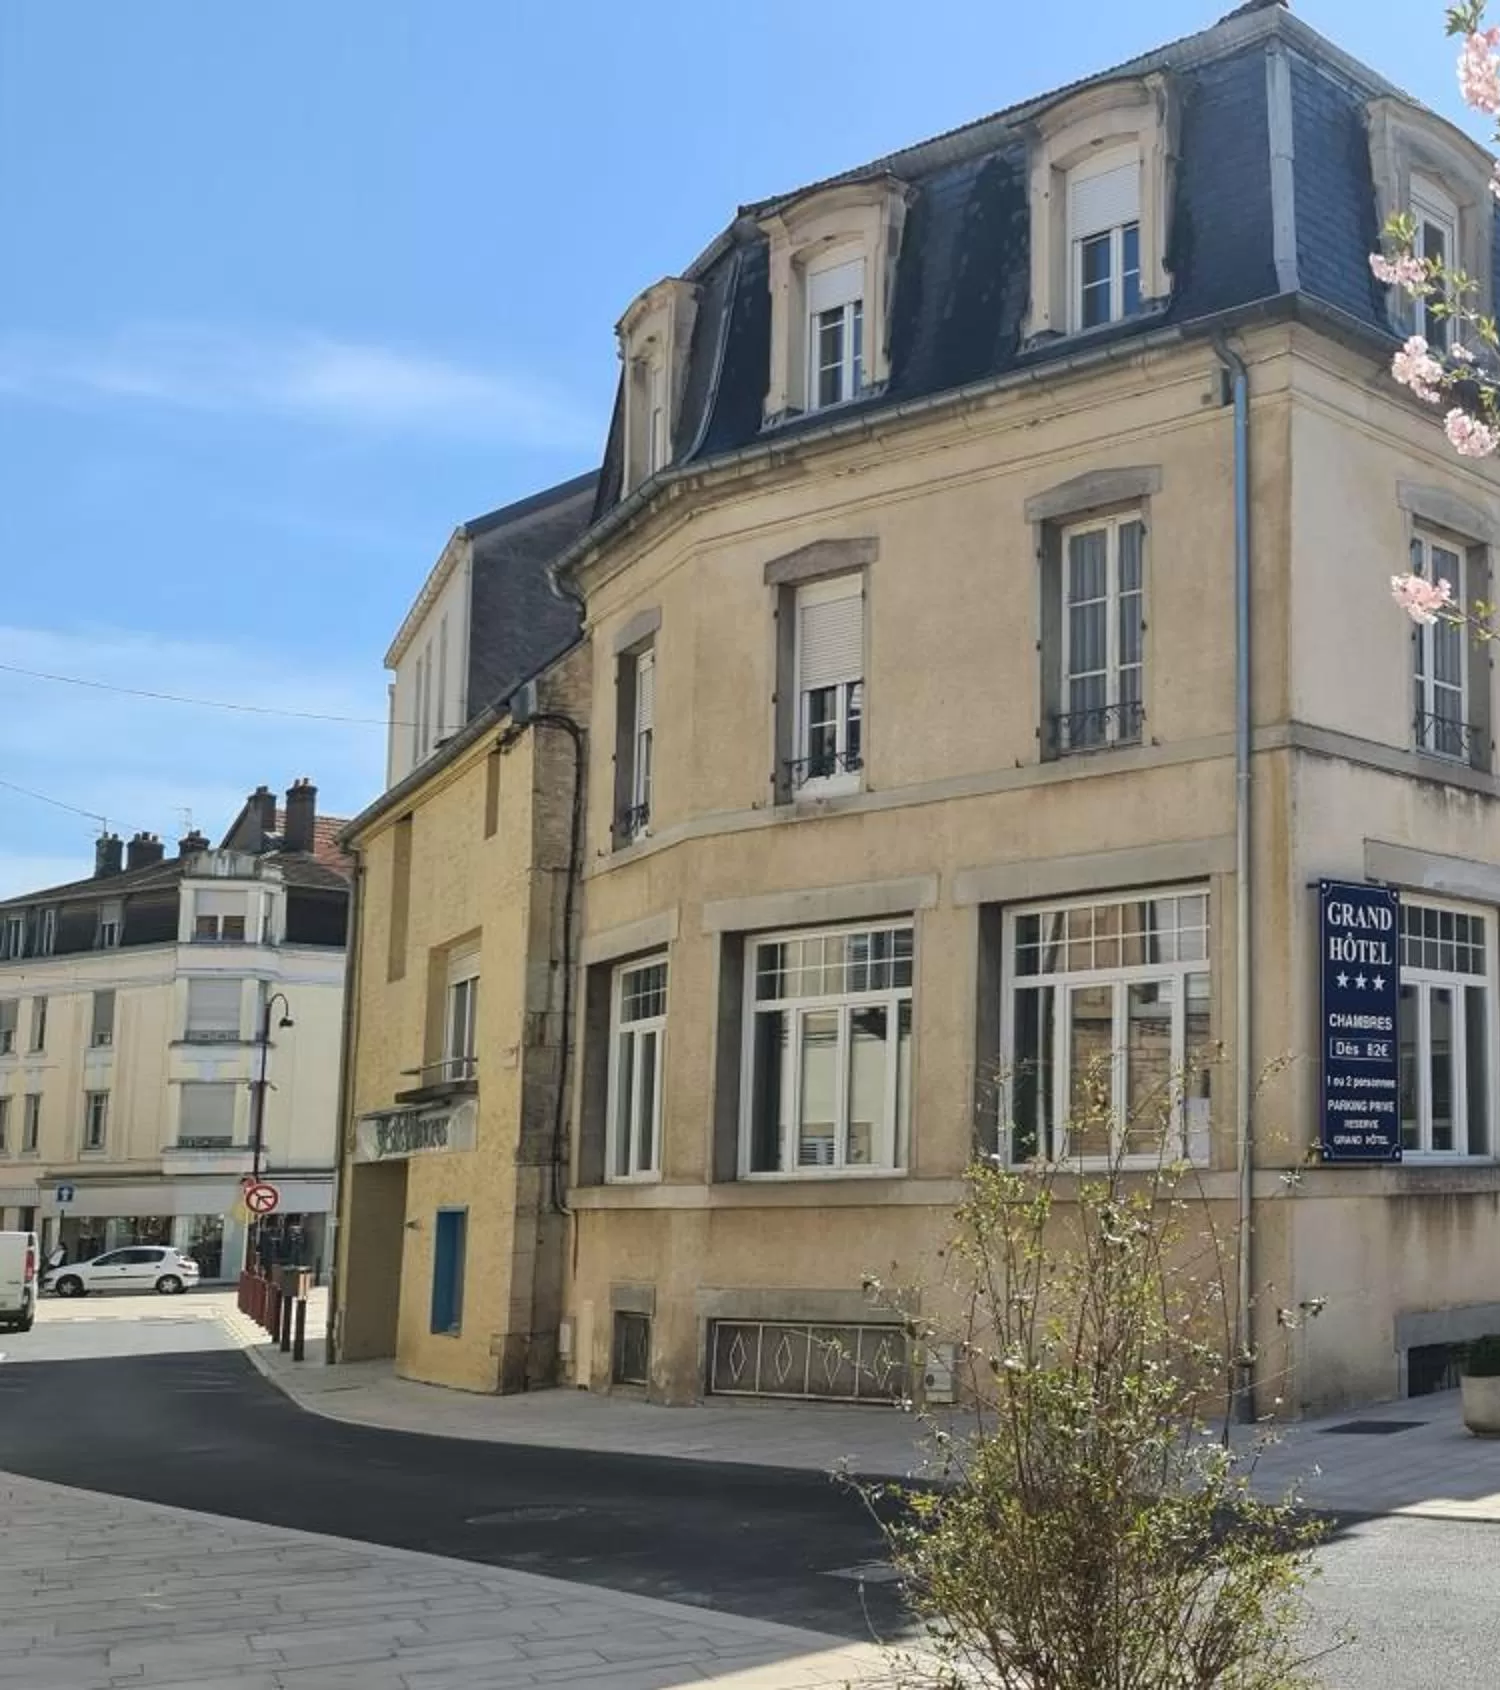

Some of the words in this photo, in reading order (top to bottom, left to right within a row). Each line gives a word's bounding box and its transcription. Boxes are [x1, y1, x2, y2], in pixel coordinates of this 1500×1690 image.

[1328, 901, 1393, 931] GRAND
[1330, 931, 1393, 965] HÔTEL
[1329, 1013, 1393, 1031] CHAMBRES
[1346, 1075, 1352, 1087] 2
[1327, 1100, 1367, 1112] PARKING
